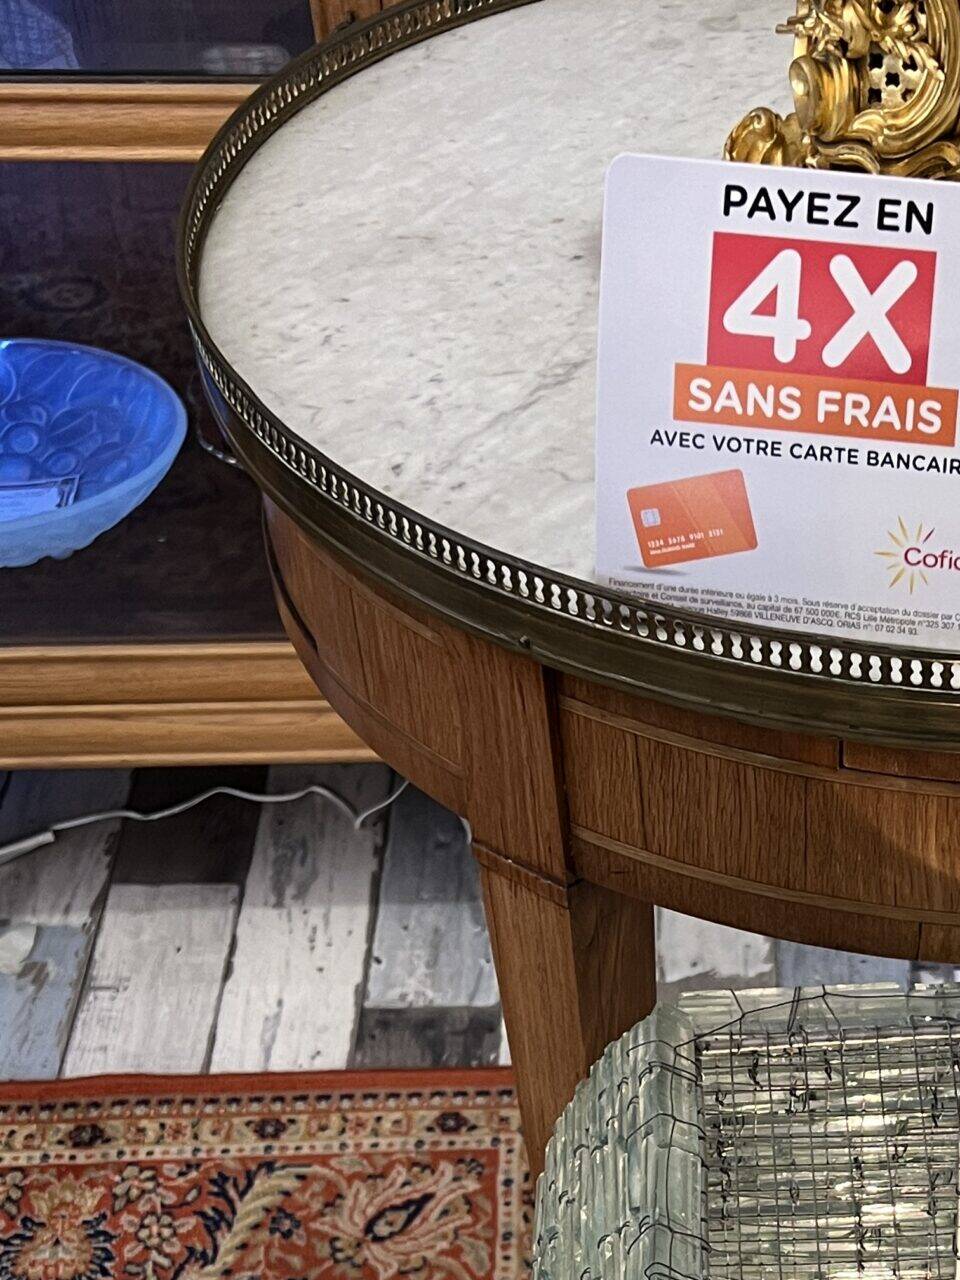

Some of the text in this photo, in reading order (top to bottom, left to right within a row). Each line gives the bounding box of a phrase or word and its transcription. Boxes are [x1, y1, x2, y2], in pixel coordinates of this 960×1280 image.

[723, 184, 934, 235] PAYEZ EN
[723, 248, 918, 374] 4X
[688, 377, 942, 433] SANS FRAIS
[650, 429, 705, 449] AVEC
[713, 435, 782, 457] VOTRE
[789, 443, 860, 465] CARTE
[608, 577, 655, 590] Financement
[656, 583, 677, 592] d'une
[678, 585, 699, 594] durée
[746, 592, 767, 602] égale
[774, 595, 780, 603] 3
[802, 597, 821, 606] Sous
[822, 600, 849, 610] réserve
[850, 603, 900, 616] d'acceptation
[901, 609, 912, 617] du
[913, 610, 939, 619] dossier
[941, 612, 953, 621] par
[651, 592, 659, 600] et
[660, 592, 688, 603] Conseil
[689, 596, 699, 604] de
[746, 602, 756, 610] au
[757, 603, 781, 614] capital
[782, 605, 793, 613] de
[794, 606, 804, 615] 67
[844, 612, 860, 621] RCS
[862, 614, 878, 623] Lille
[879, 614, 916, 628] Métropole
[941, 621, 955, 630] 307
[754, 611, 801, 624] VILLENEUVE
[836, 619, 861, 630] ORIAS
[874, 623, 885, 631] 07
[886, 625, 896, 633] 02
[896, 626, 906, 634] 34
